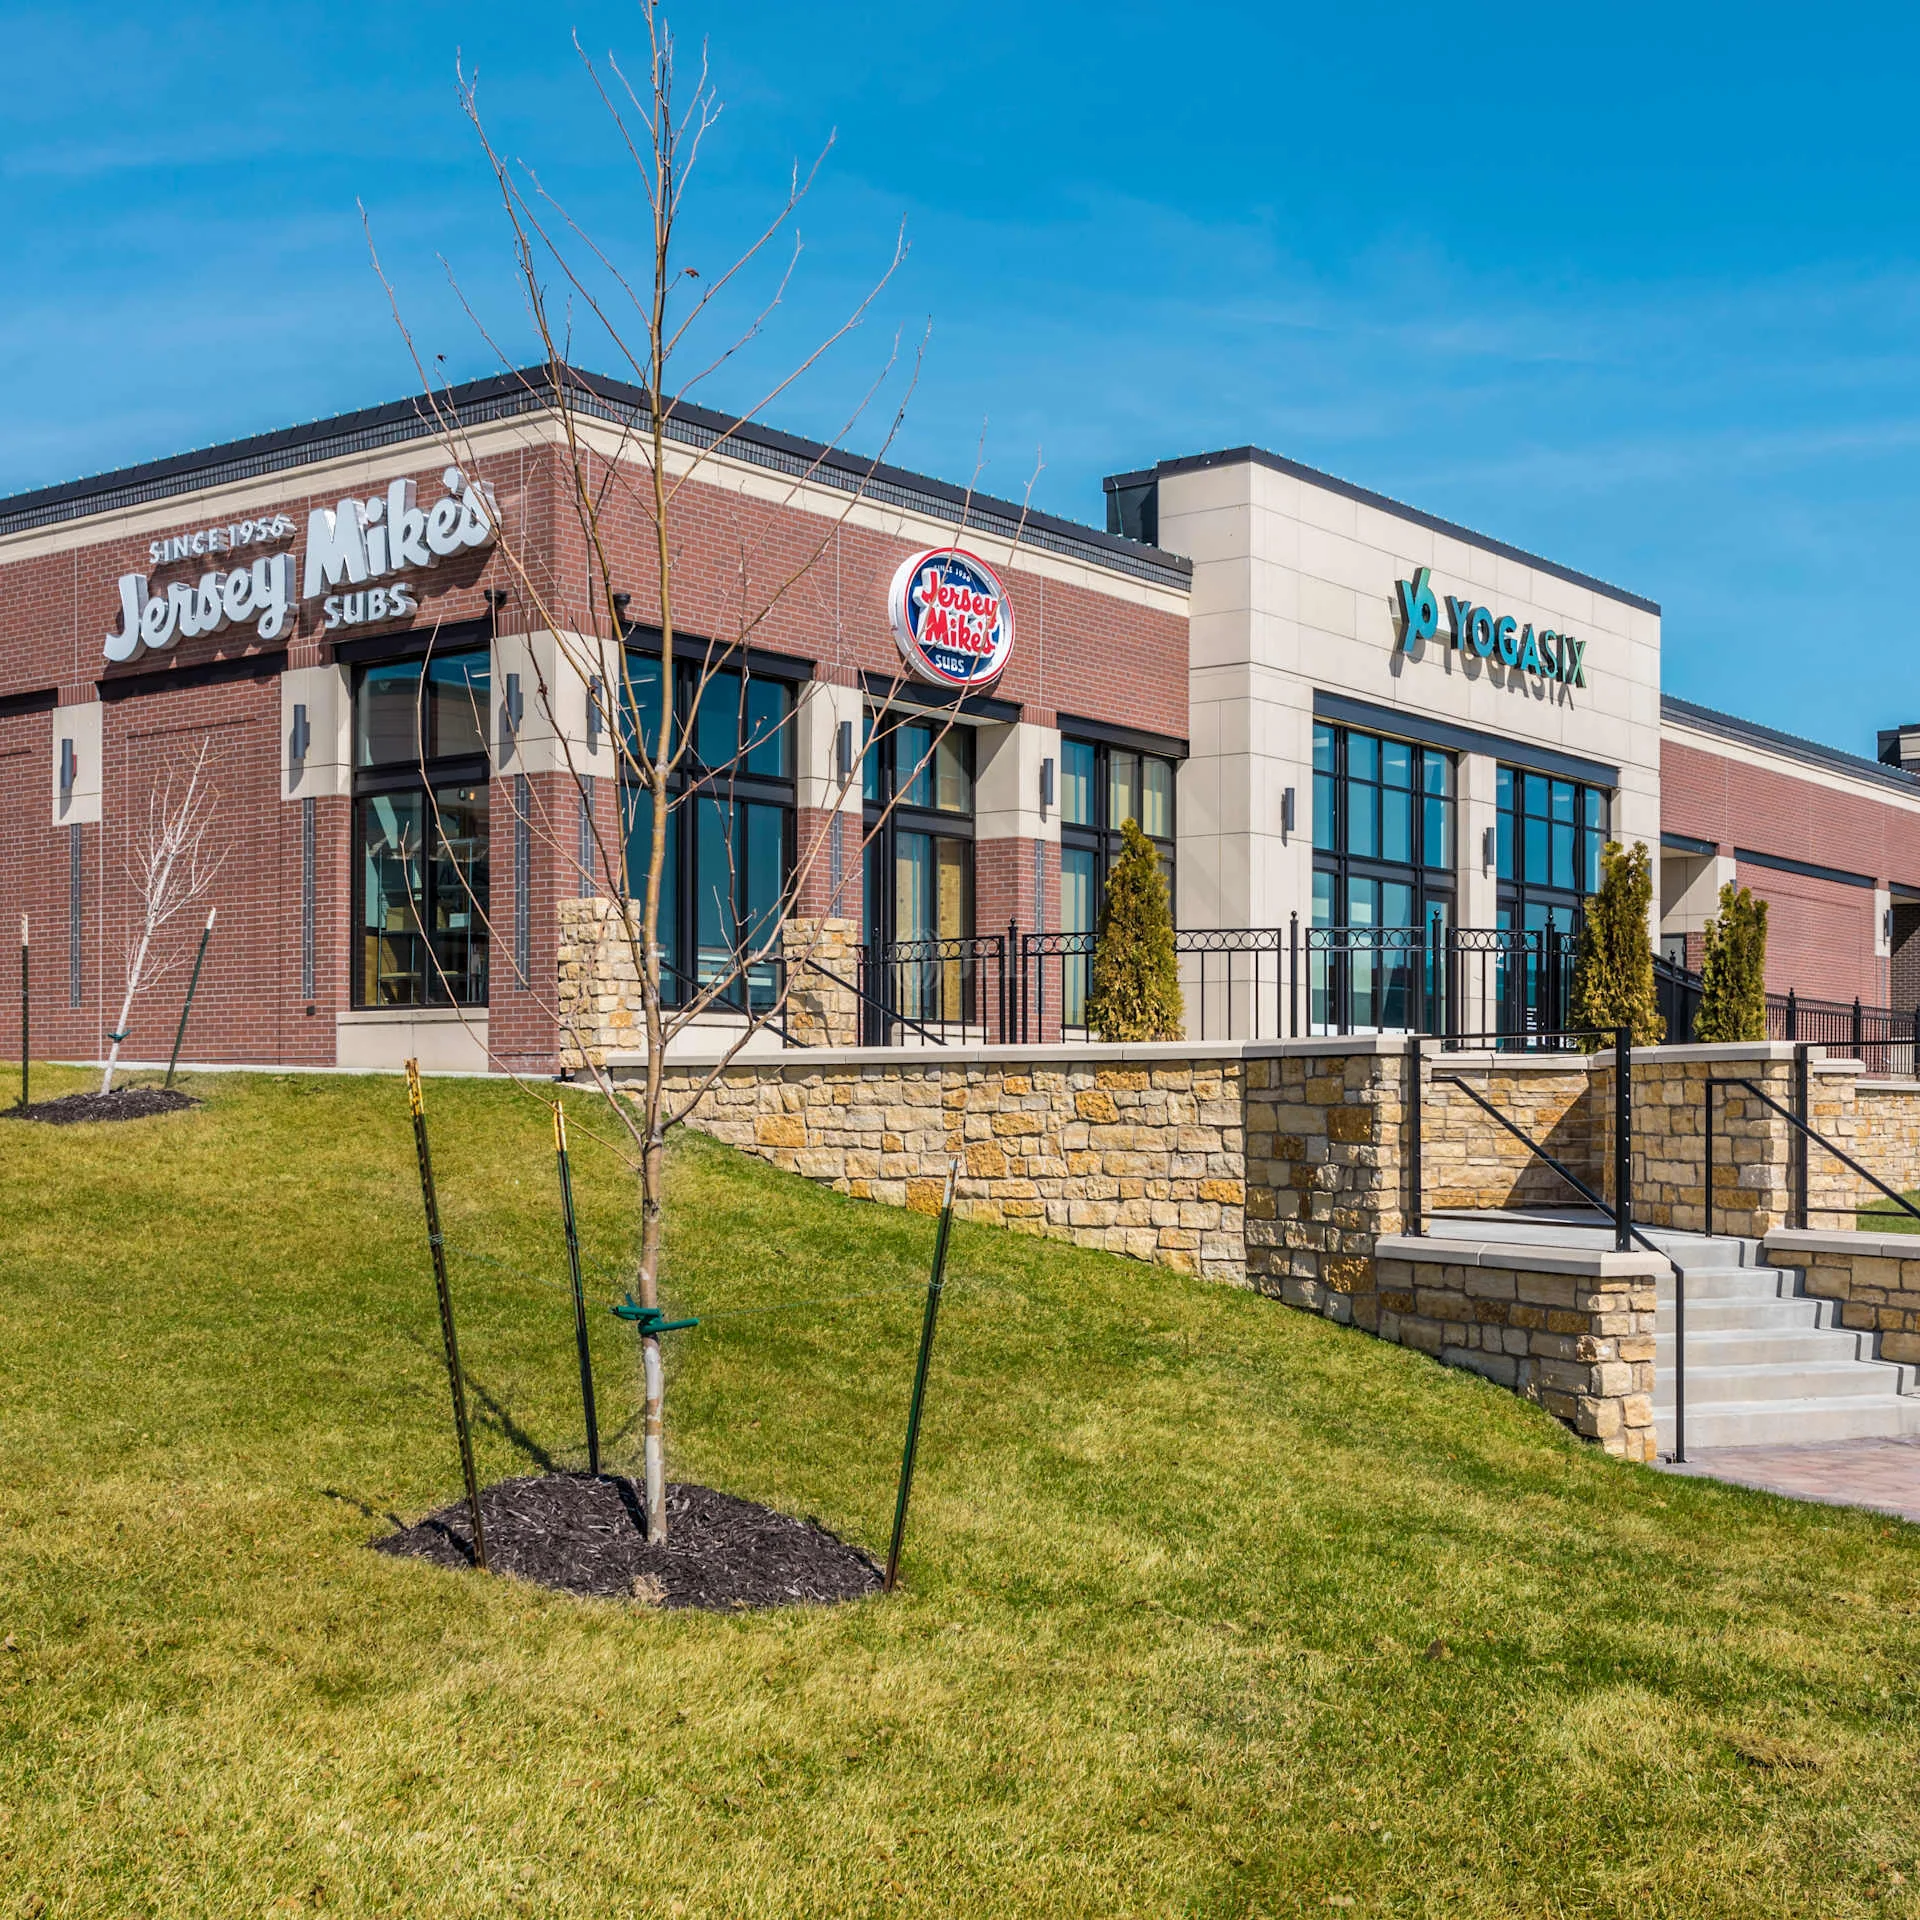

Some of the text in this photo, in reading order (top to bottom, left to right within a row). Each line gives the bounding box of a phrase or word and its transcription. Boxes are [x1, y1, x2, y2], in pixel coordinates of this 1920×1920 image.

[149, 513, 294, 564] SINCE 1956
[103, 467, 501, 662] Jersey Mike's
[324, 583, 417, 630] SUBS
[921, 571, 998, 630] Jersey
[925, 607, 996, 655] Mike's
[1444, 595, 1587, 689] YOGASIX
[935, 654, 965, 673] SUBS
